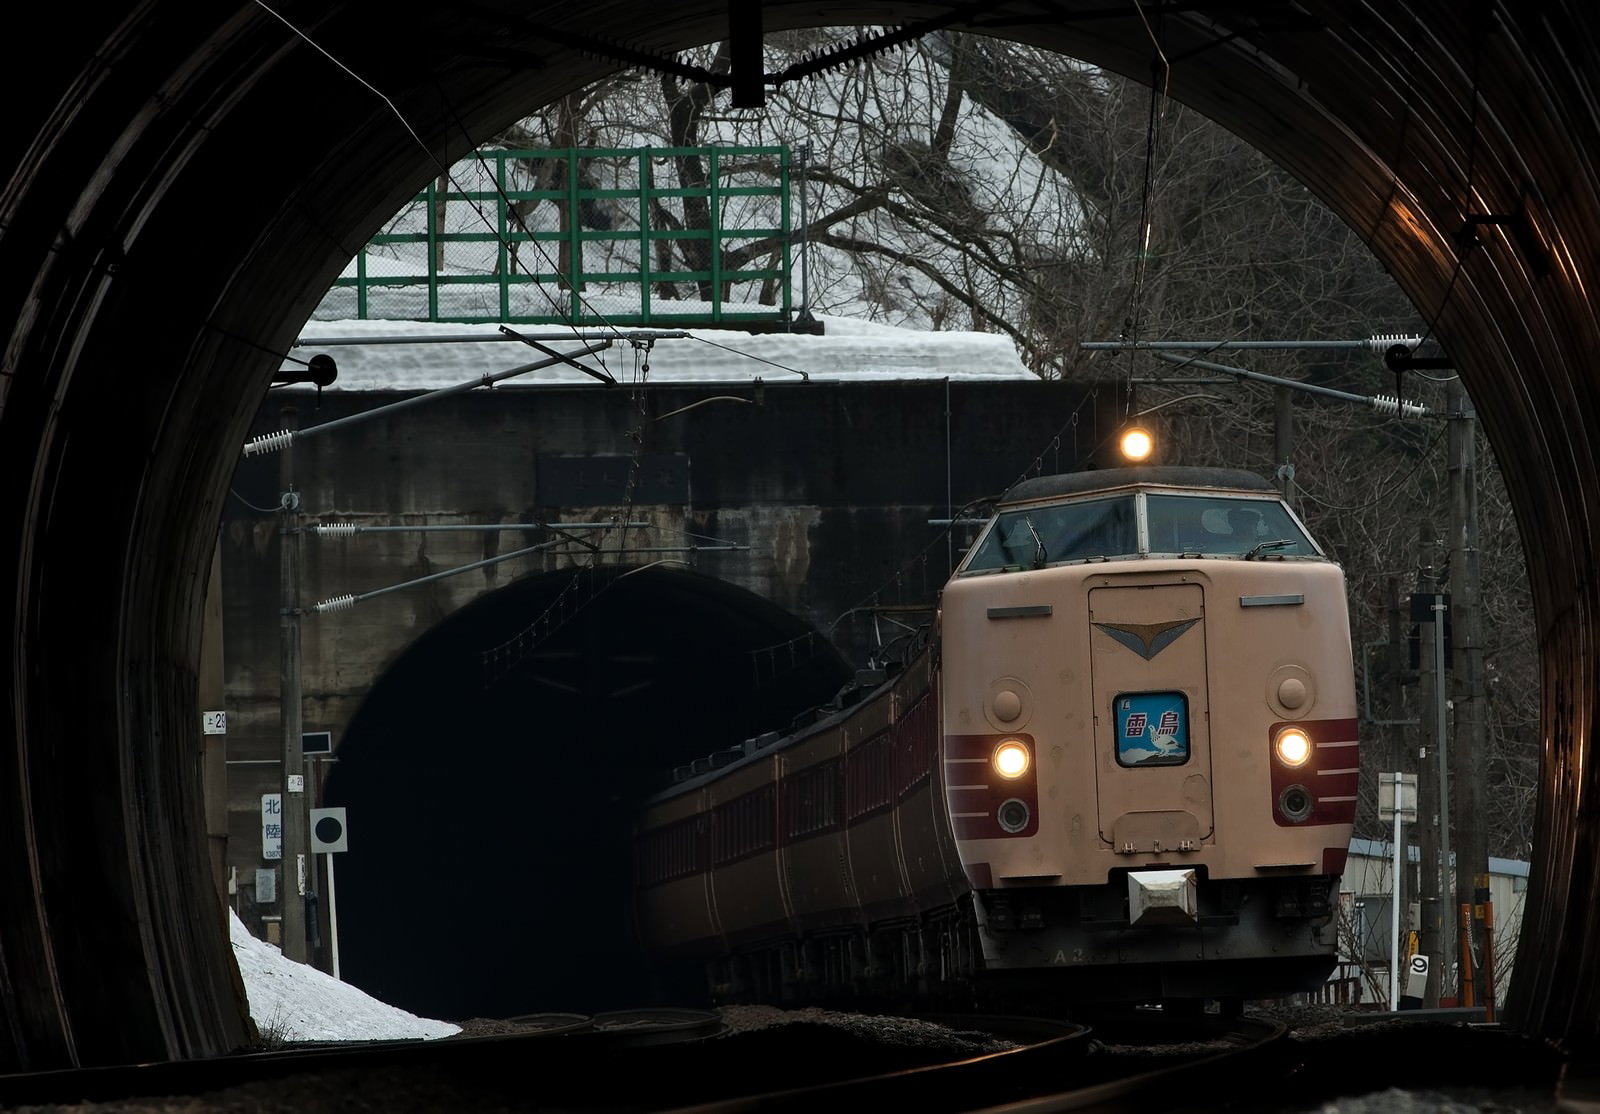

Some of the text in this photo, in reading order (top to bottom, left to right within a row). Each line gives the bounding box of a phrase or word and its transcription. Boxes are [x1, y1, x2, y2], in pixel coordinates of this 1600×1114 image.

[1125, 711, 1179, 738] 雷鳥
[265, 799, 281, 840] 北陸
[1412, 957, 1427, 973] 9
